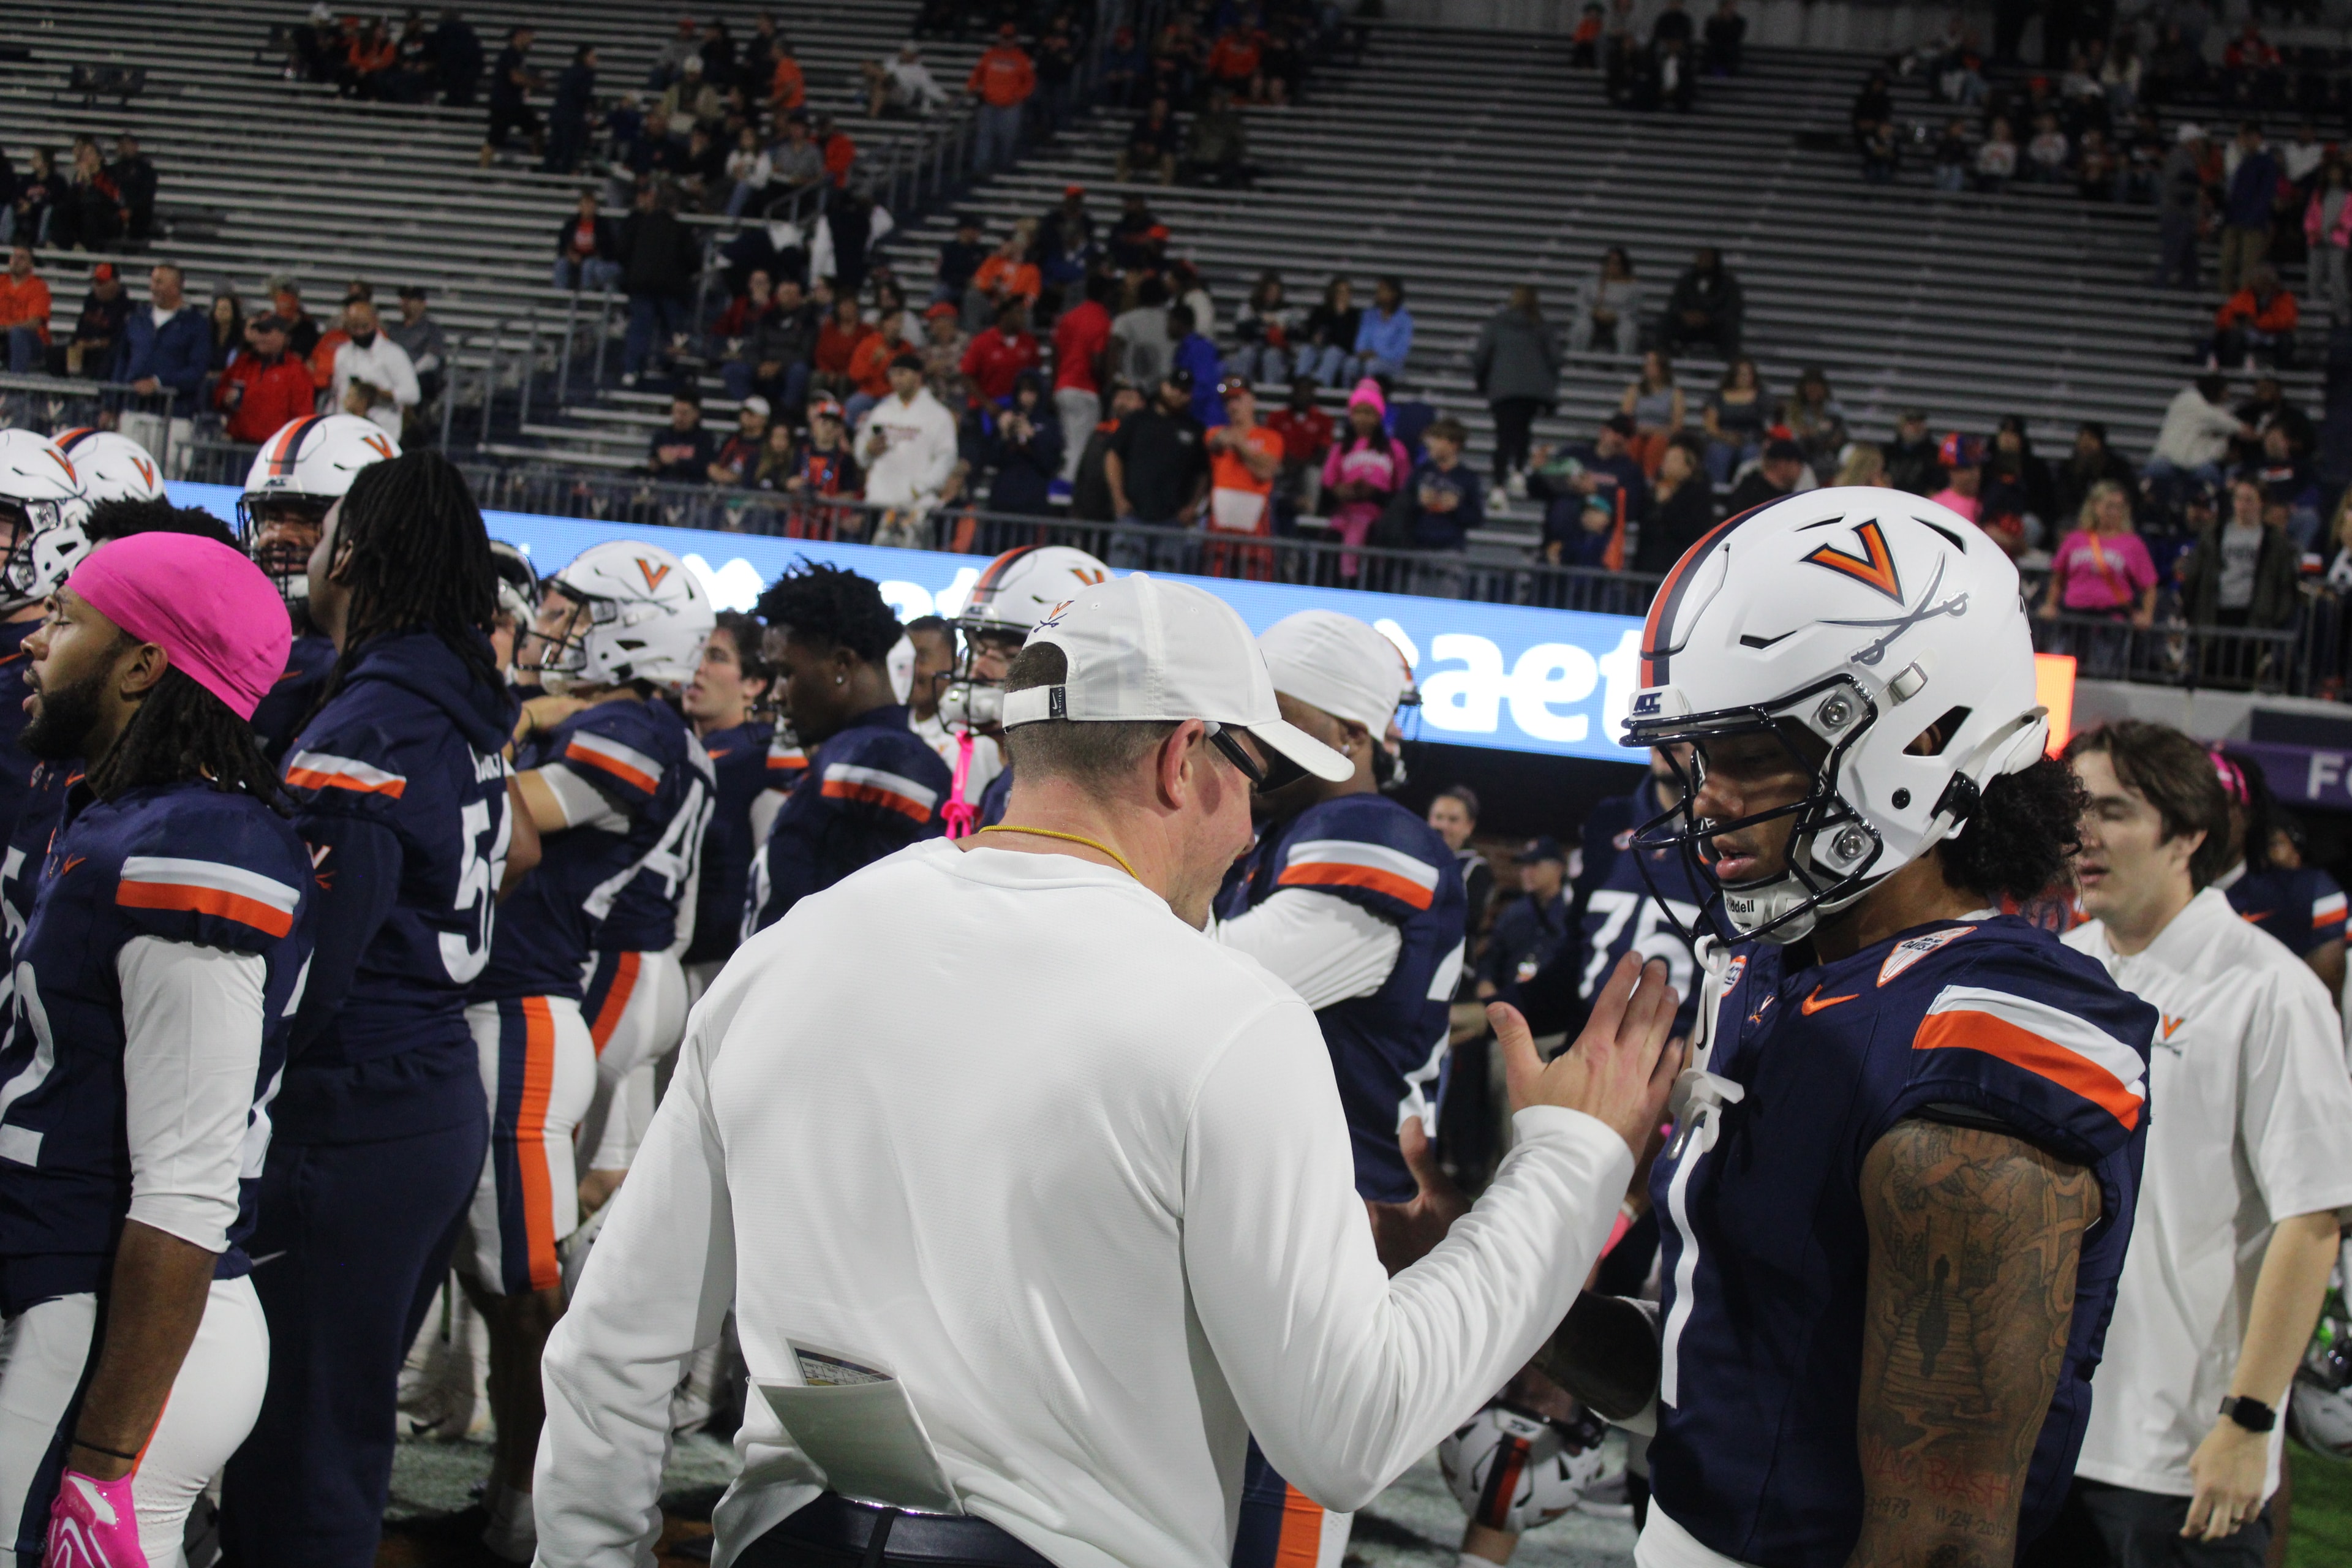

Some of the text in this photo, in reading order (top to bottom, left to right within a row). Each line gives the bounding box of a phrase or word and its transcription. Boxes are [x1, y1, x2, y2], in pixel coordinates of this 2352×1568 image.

[634, 557, 671, 593] V
[1798, 518, 1906, 608] V
[1632, 692, 1663, 716] ACC
[2307, 751, 2352, 800] F
[1578, 889, 1703, 1006] 75
[2162, 1013, 2186, 1041] V
